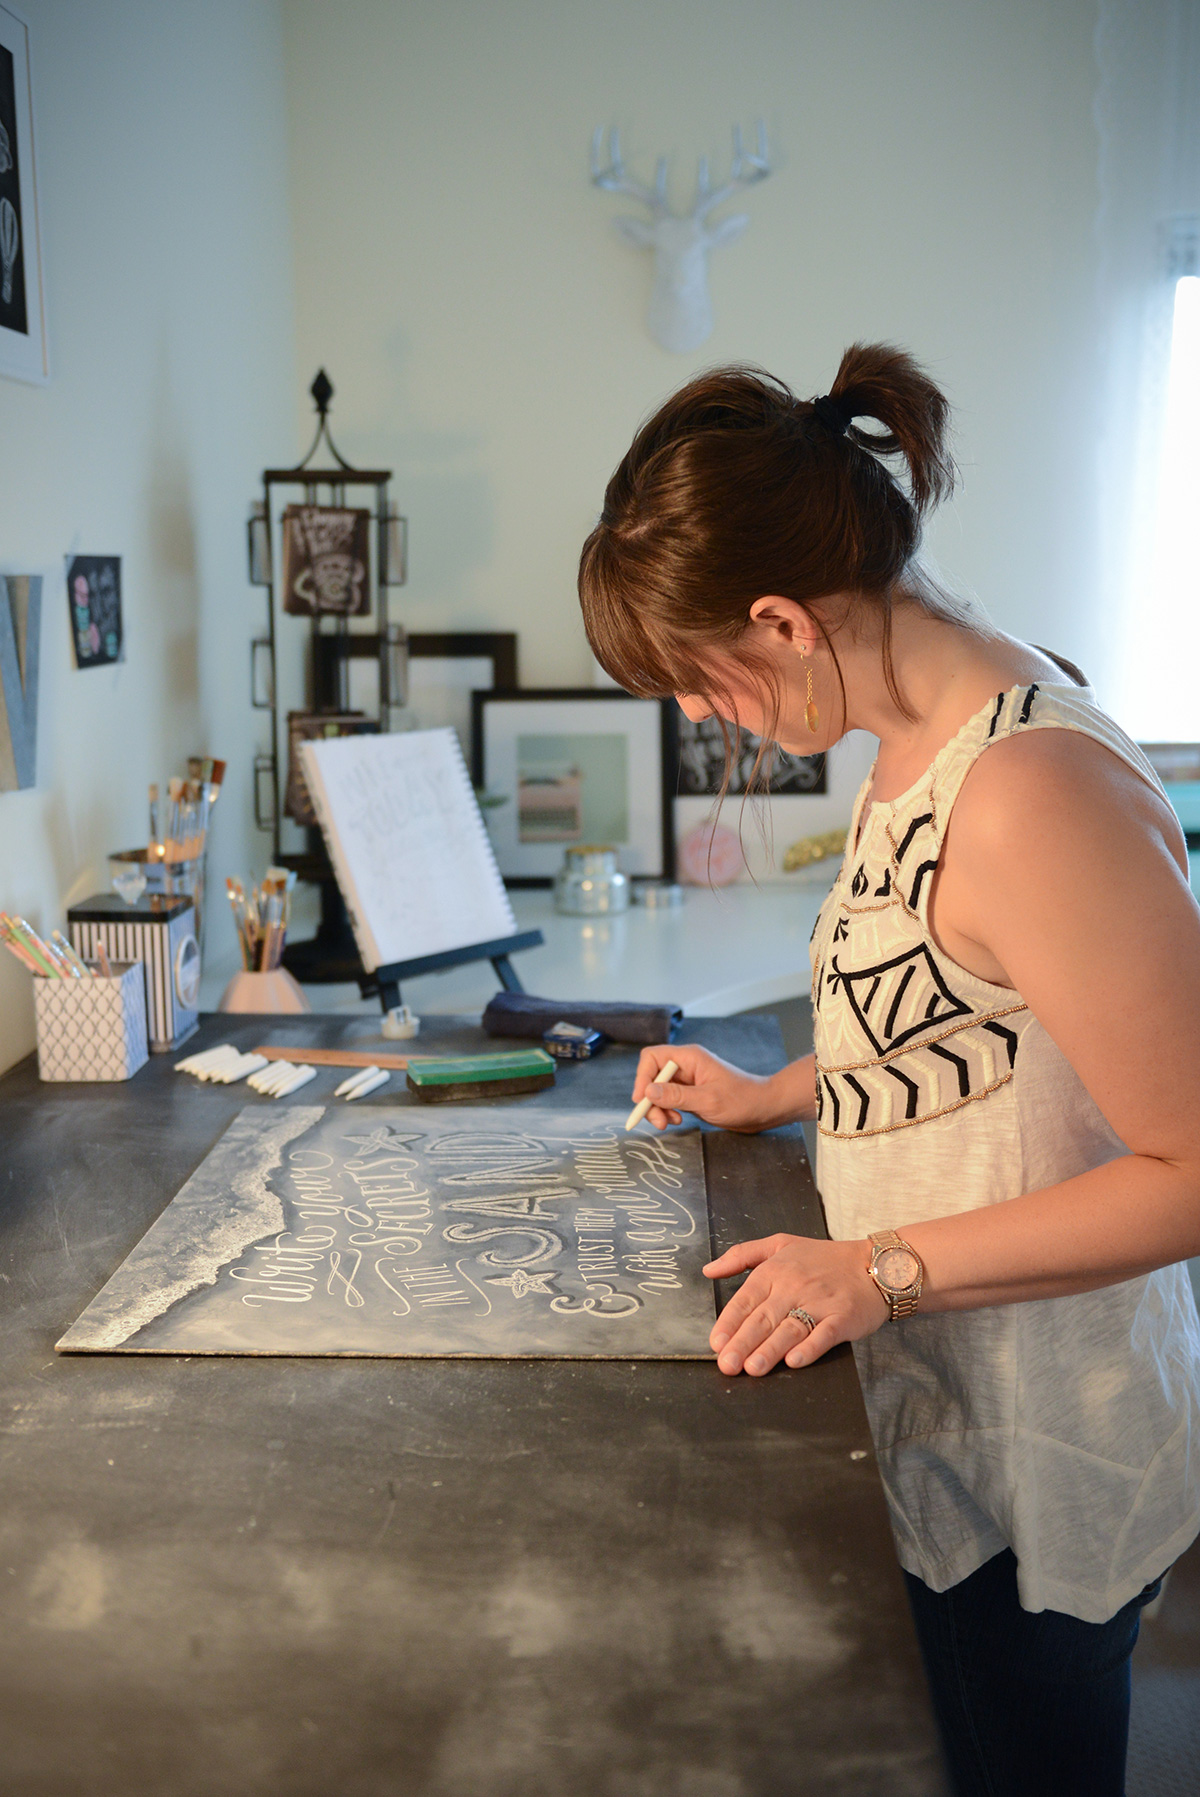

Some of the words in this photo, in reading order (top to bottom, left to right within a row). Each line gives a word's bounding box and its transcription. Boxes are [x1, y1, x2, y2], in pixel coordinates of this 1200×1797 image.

[523, 1130, 679, 1227] mermaid
[338, 1158, 434, 1255] SECRETS
[424, 1131, 580, 1269] SAND
[573, 1207, 617, 1233] THEM
[229, 1226, 338, 1308] Write
[289, 1151, 374, 1227] your
[625, 1226, 667, 1242] a
[393, 1263, 458, 1290] THE
[577, 1236, 620, 1282] TRUST
[413, 1290, 471, 1308] IN
[550, 1282, 640, 1319] &
